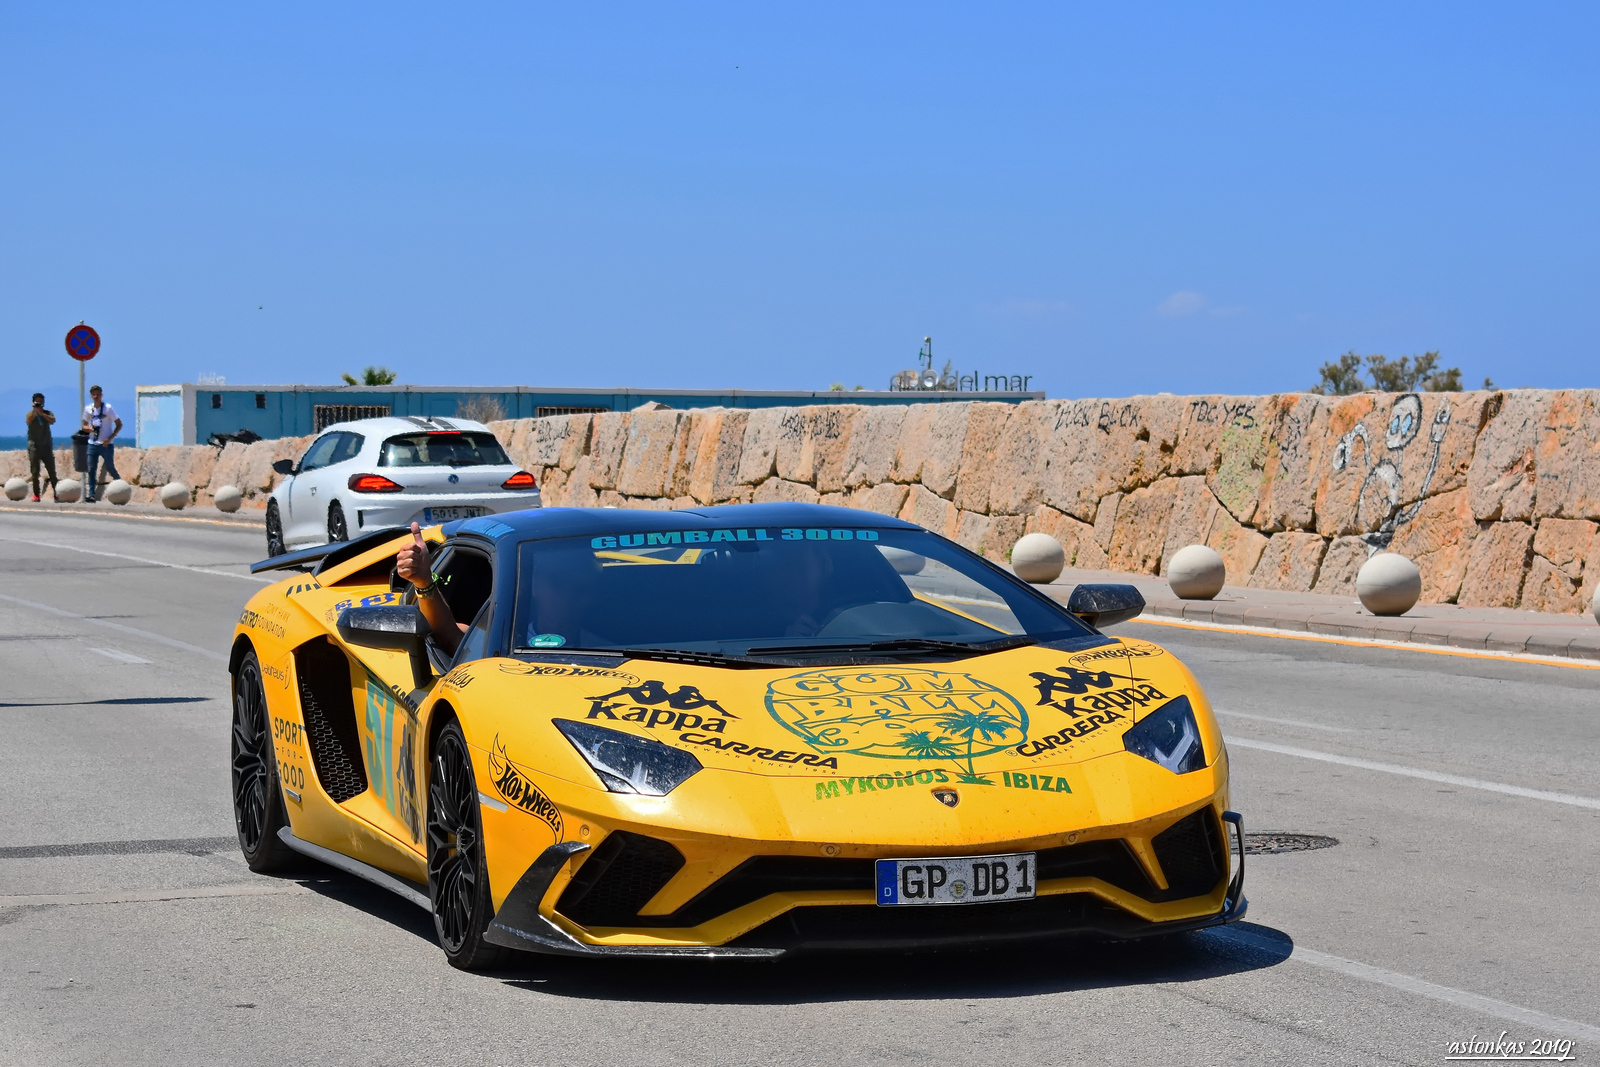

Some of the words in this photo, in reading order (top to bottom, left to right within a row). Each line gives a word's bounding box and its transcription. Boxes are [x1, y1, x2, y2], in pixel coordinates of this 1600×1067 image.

[984, 374, 1033, 391] mar
[591, 529, 774, 549] GUMBALL
[781, 528, 879, 541] 3000
[584, 700, 727, 735] Kappa
[1047, 684, 1171, 720] Kappa
[274, 716, 305, 747] SPORT
[1016, 710, 1127, 758] CARRERA
[1031, 745, 1075, 764] EYEWEAR
[1080, 728, 1109, 744] SINCE
[674, 743, 741, 759] EYEWEAR
[751, 758, 793, 770] SINCE
[805, 766, 837, 776] 1956
[679, 732, 838, 770] CARRERA
[815, 768, 950, 801] MYKONOS
[1002, 770, 1073, 795] IBIZA
[883, 886, 892, 897] D
[902, 864, 947, 899] GP
[972, 861, 1009, 897] DB
[1016, 859, 1032, 894] 1
